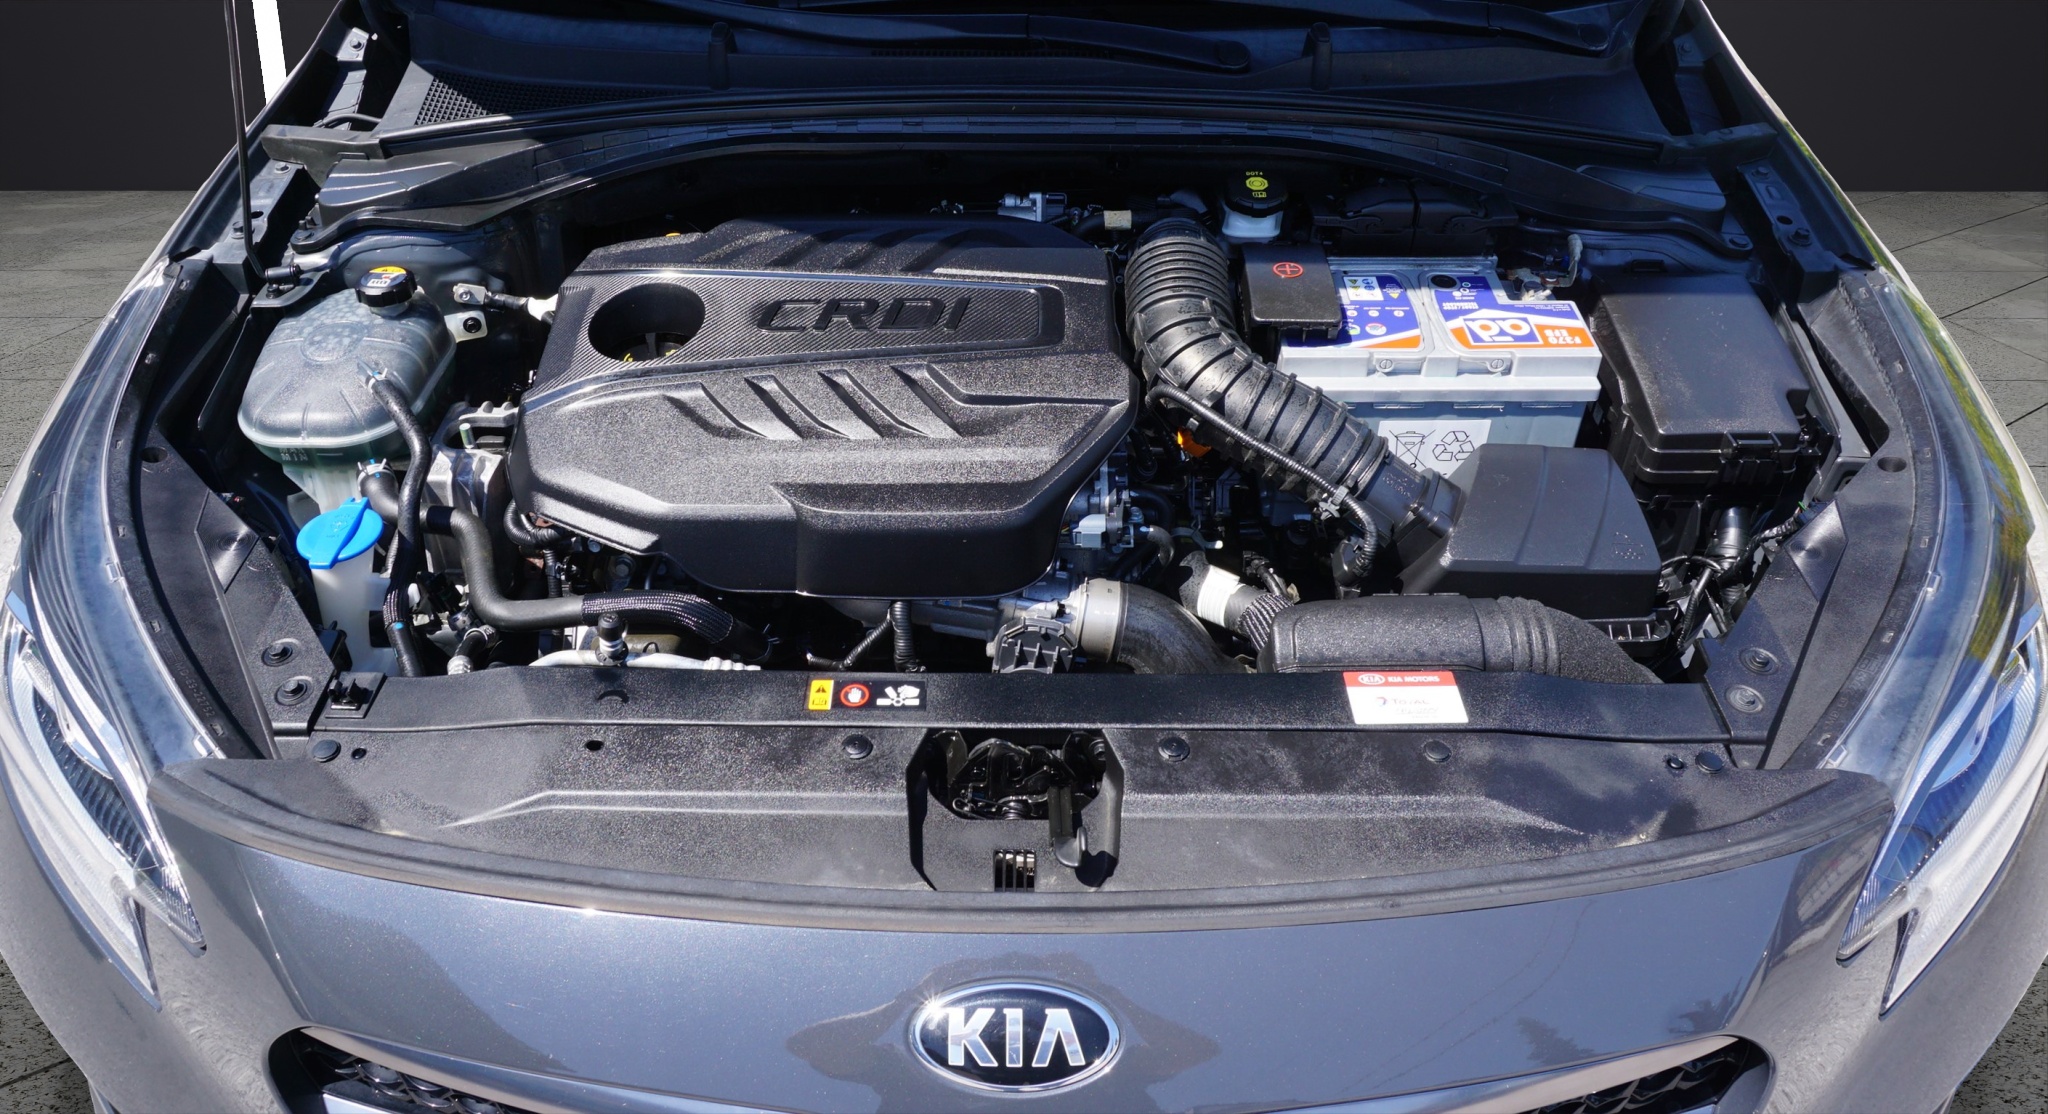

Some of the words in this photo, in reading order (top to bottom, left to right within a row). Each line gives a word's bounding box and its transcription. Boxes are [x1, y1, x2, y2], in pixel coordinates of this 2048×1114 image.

[757, 298, 971, 331] CRDI
[1548, 336, 1582, 344] F370
[947, 1007, 1086, 1067] KIA
